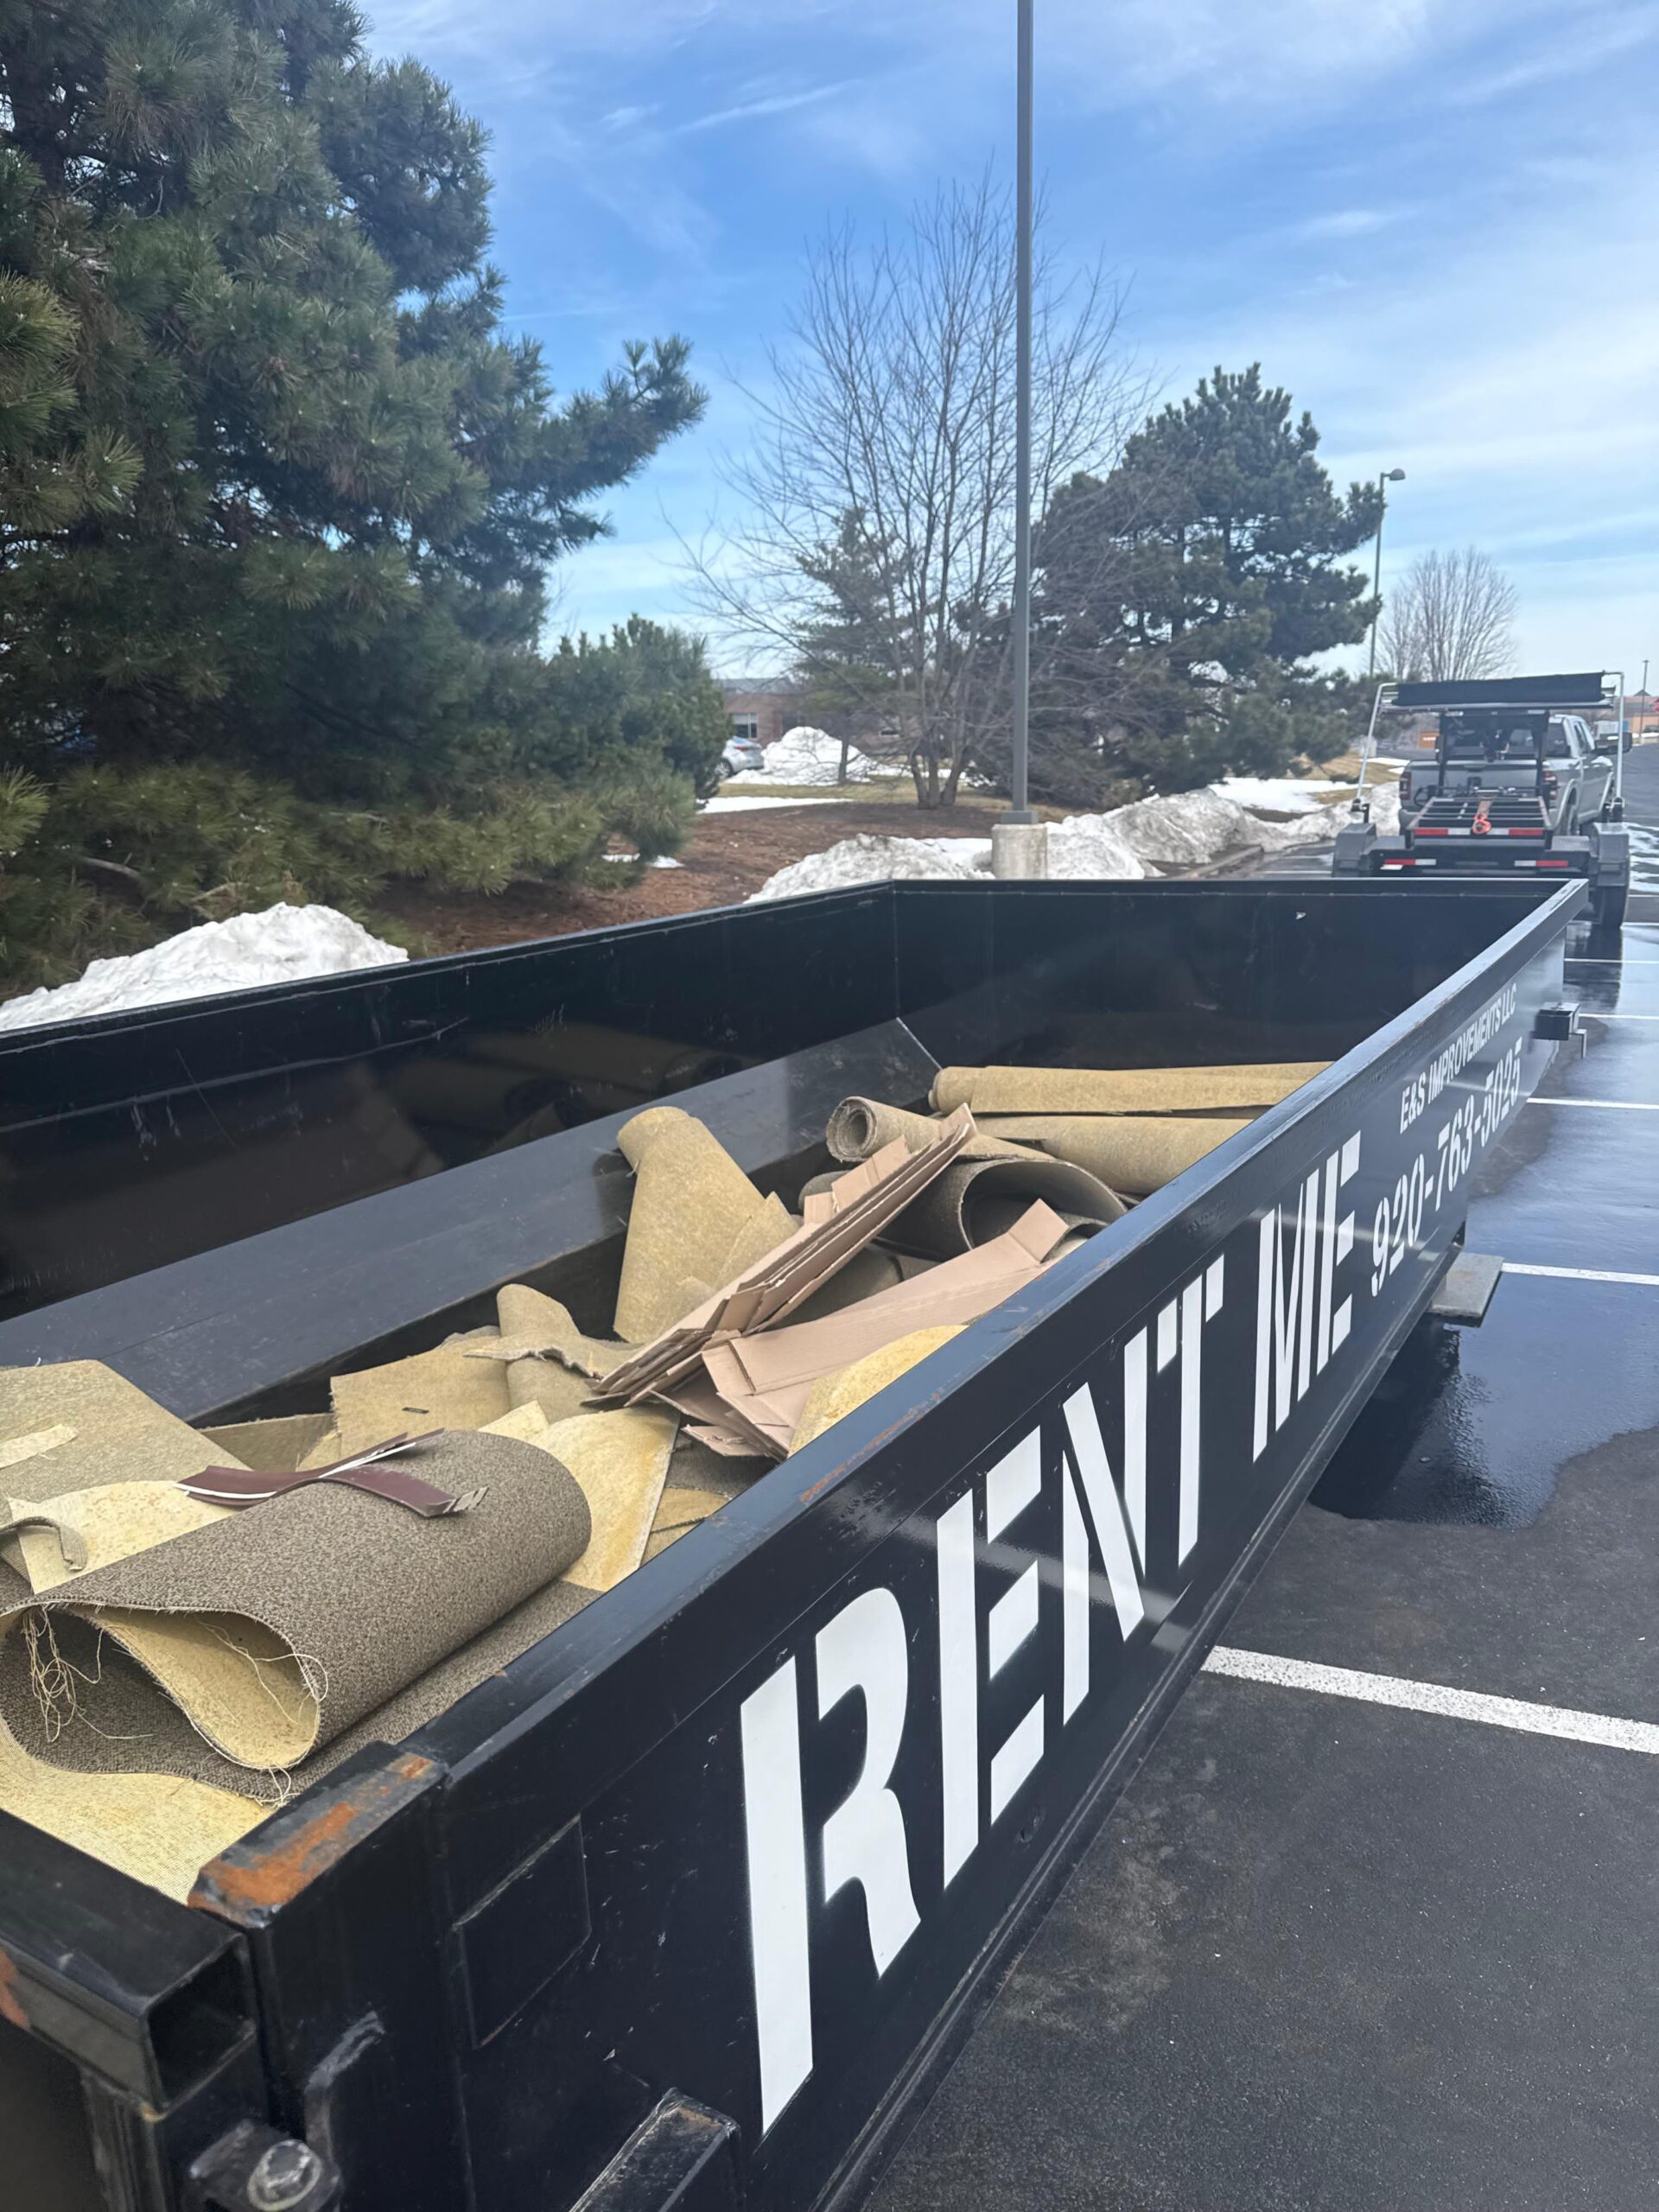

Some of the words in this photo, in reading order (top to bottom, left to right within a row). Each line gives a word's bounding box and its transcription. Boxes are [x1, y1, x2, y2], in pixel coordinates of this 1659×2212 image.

[1371, 1037, 1522, 1297] 920-763-5025
[1400, 1071, 1426, 1134] E&S
[1427, 996, 1502, 1105] IMPROVEMENTS
[1501, 982, 1516, 1025] LLC
[741, 1255, 1224, 2134] RENT
[1253, 1130, 1361, 1463] ME
